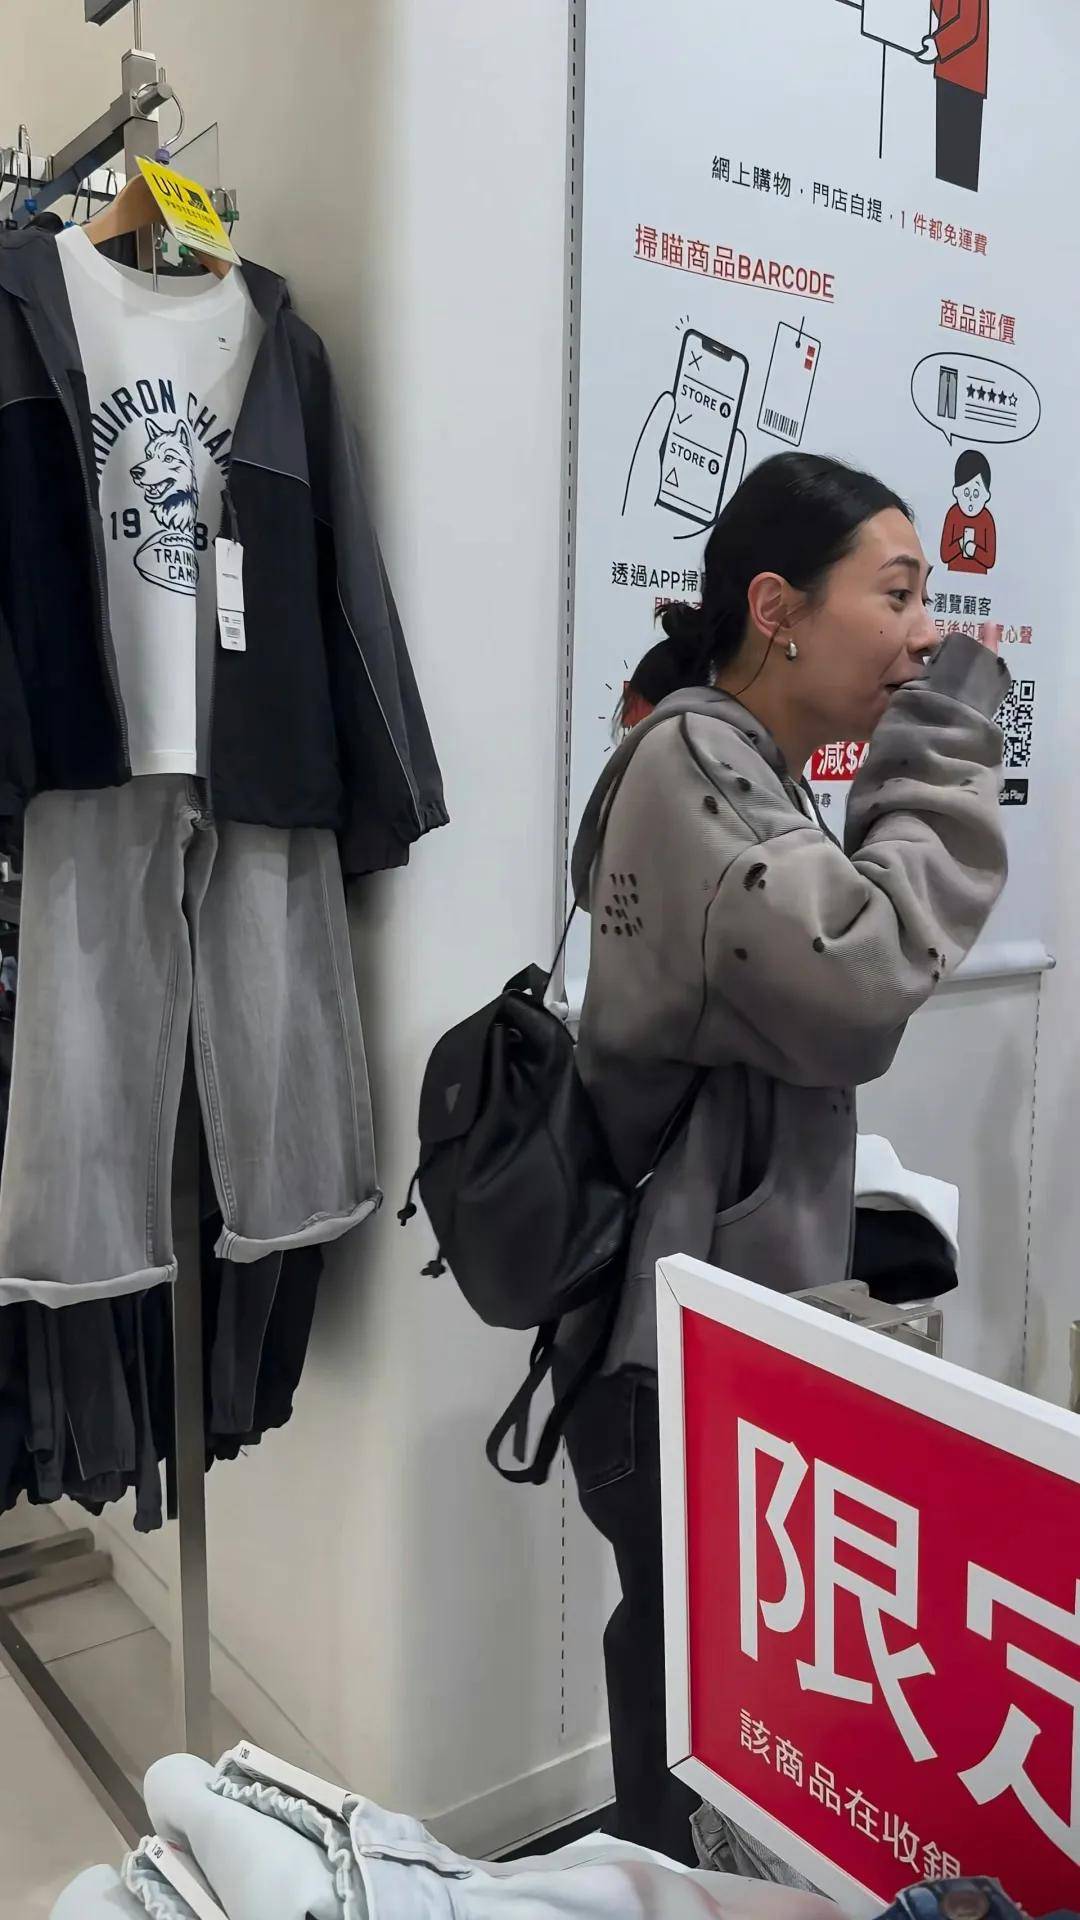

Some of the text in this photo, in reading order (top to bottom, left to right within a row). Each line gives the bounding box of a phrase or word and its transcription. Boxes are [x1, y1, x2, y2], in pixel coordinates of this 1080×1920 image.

[152, 173, 184, 203] UV
[164, 199, 217, 227] PROTECTION
[913, 211, 988, 256] 件都免運費
[635, 224, 835, 299] 掃瞄商品BARCODE
[939, 299, 1016, 344] 商品評價
[681, 384, 717, 411] STORE
[91, 379, 176, 475] DIRON
[670, 442, 706, 468] STORE
[110, 508, 216, 551] 19 8
[933, 593, 992, 616] 瀏覽顧客
